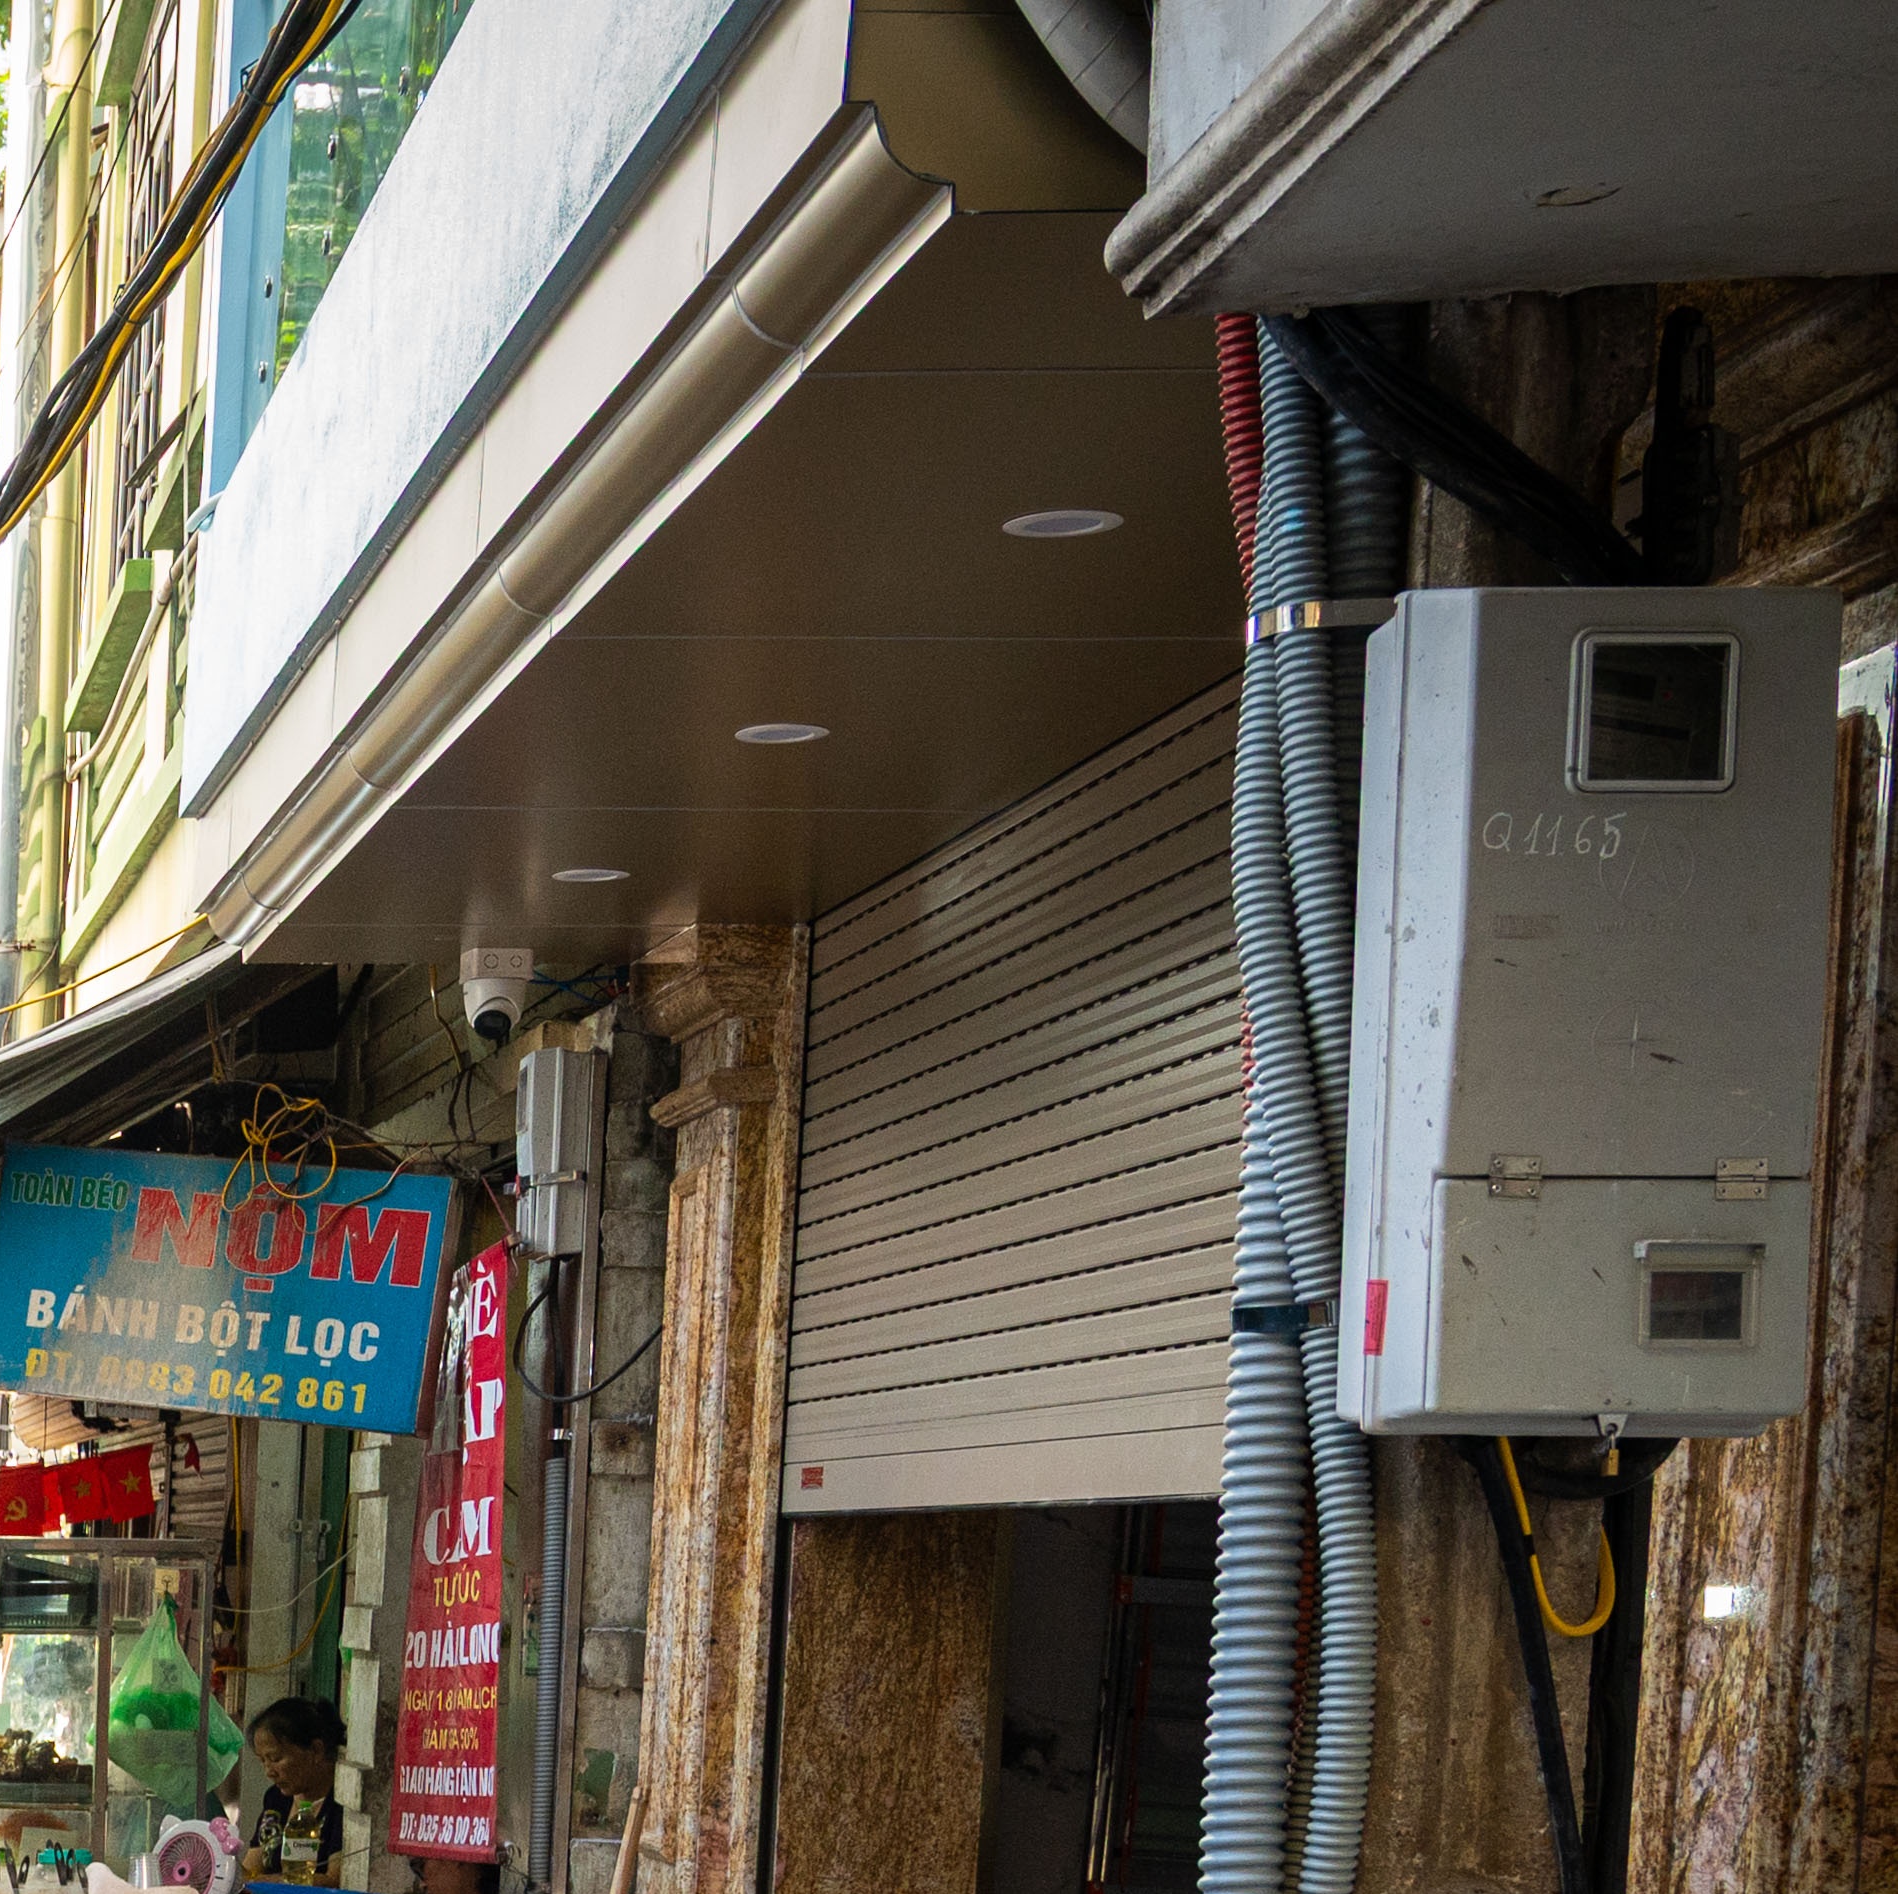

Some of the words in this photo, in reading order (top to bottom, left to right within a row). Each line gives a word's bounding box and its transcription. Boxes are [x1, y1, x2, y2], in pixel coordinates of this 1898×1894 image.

[11, 1168, 75, 1207] TOÀN
[79, 1173, 129, 1212] BÉO
[131, 1181, 432, 1293] NỘM
[25, 1285, 160, 1340] BÁNH
[174, 1300, 271, 1357] BỘT
[284, 1315, 381, 1367] LỌC
[209, 1369, 283, 1405] 042
[296, 1377, 367, 1415] 861
[405, 1630, 427, 1669] 20
